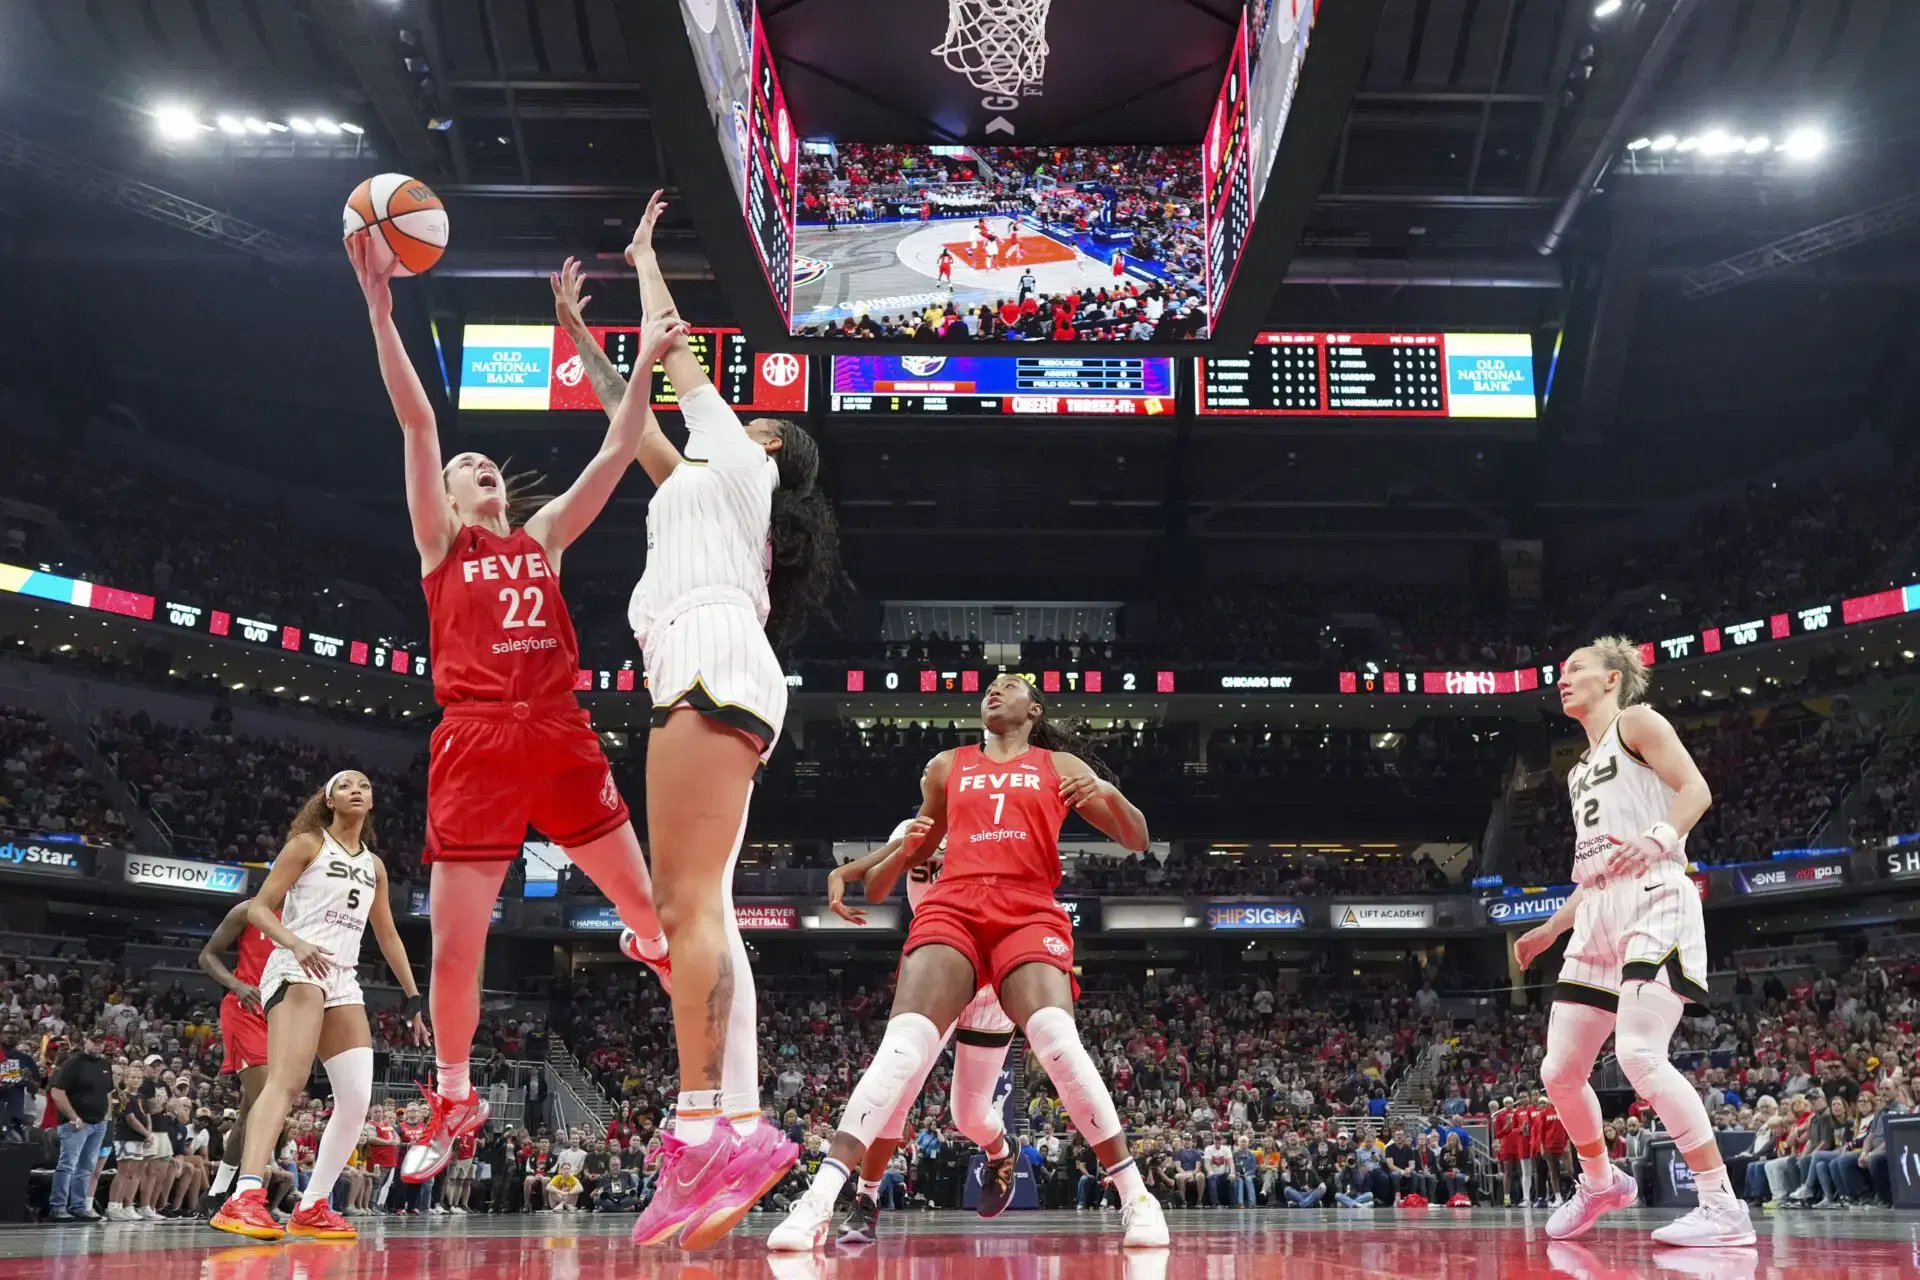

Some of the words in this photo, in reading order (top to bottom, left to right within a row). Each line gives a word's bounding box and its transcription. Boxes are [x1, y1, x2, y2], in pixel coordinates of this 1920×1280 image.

[980, 0, 1019, 111] GAINBRI
[493, 351, 522, 362] OLD
[471, 361, 541, 373] NATIONAL
[1476, 359, 1505, 370] OLD
[486, 372, 527, 384] BANK
[1457, 369, 1525, 381] NATIONAL
[1472, 380, 1513, 392] BANK
[463, 552, 552, 583] FEVE
[498, 586, 547, 629] 22
[169, 610, 196, 627] 0/0
[1803, 613, 1828, 631] 0/0
[243, 626, 269, 642] 0/0
[1733, 628, 1757, 645] 0/0
[314, 642, 337, 657] 0/0
[1668, 643, 1688, 659] 1/1
[375, 655, 384, 667] 0
[416, 663, 425, 675] 0
[601, 677, 609, 690] 5
[886, 672, 898, 689] 0
[1068, 678, 1076, 690] 1
[1123, 673, 1136, 690] 2
[1221, 676, 1269, 688] CHICAGO
[1270, 676, 1292, 688] SKY
[1366, 680, 1374, 691] 0
[1544, 672, 1553, 685] 0
[959, 773, 1041, 793] FEVER
[989, 793, 1005, 825] 7
[970, 828, 1027, 843] salesforce
[128, 861, 208, 883] SECTION
[210, 871, 238, 887] 127
[326, 860, 375, 889] SKY
[911, 860, 944, 884] SK
[347, 888, 361, 910] 5
[1514, 896, 1569, 915] HYUND
[764, 908, 796, 917] FEVER
[1207, 907, 1306, 925] SHIPSIGMA
[1359, 909, 1378, 919] LIFT
[1380, 909, 1426, 919] ACADEMY
[737, 917, 790, 927] SKETBALL
[1072, 915, 1081, 927] 2
